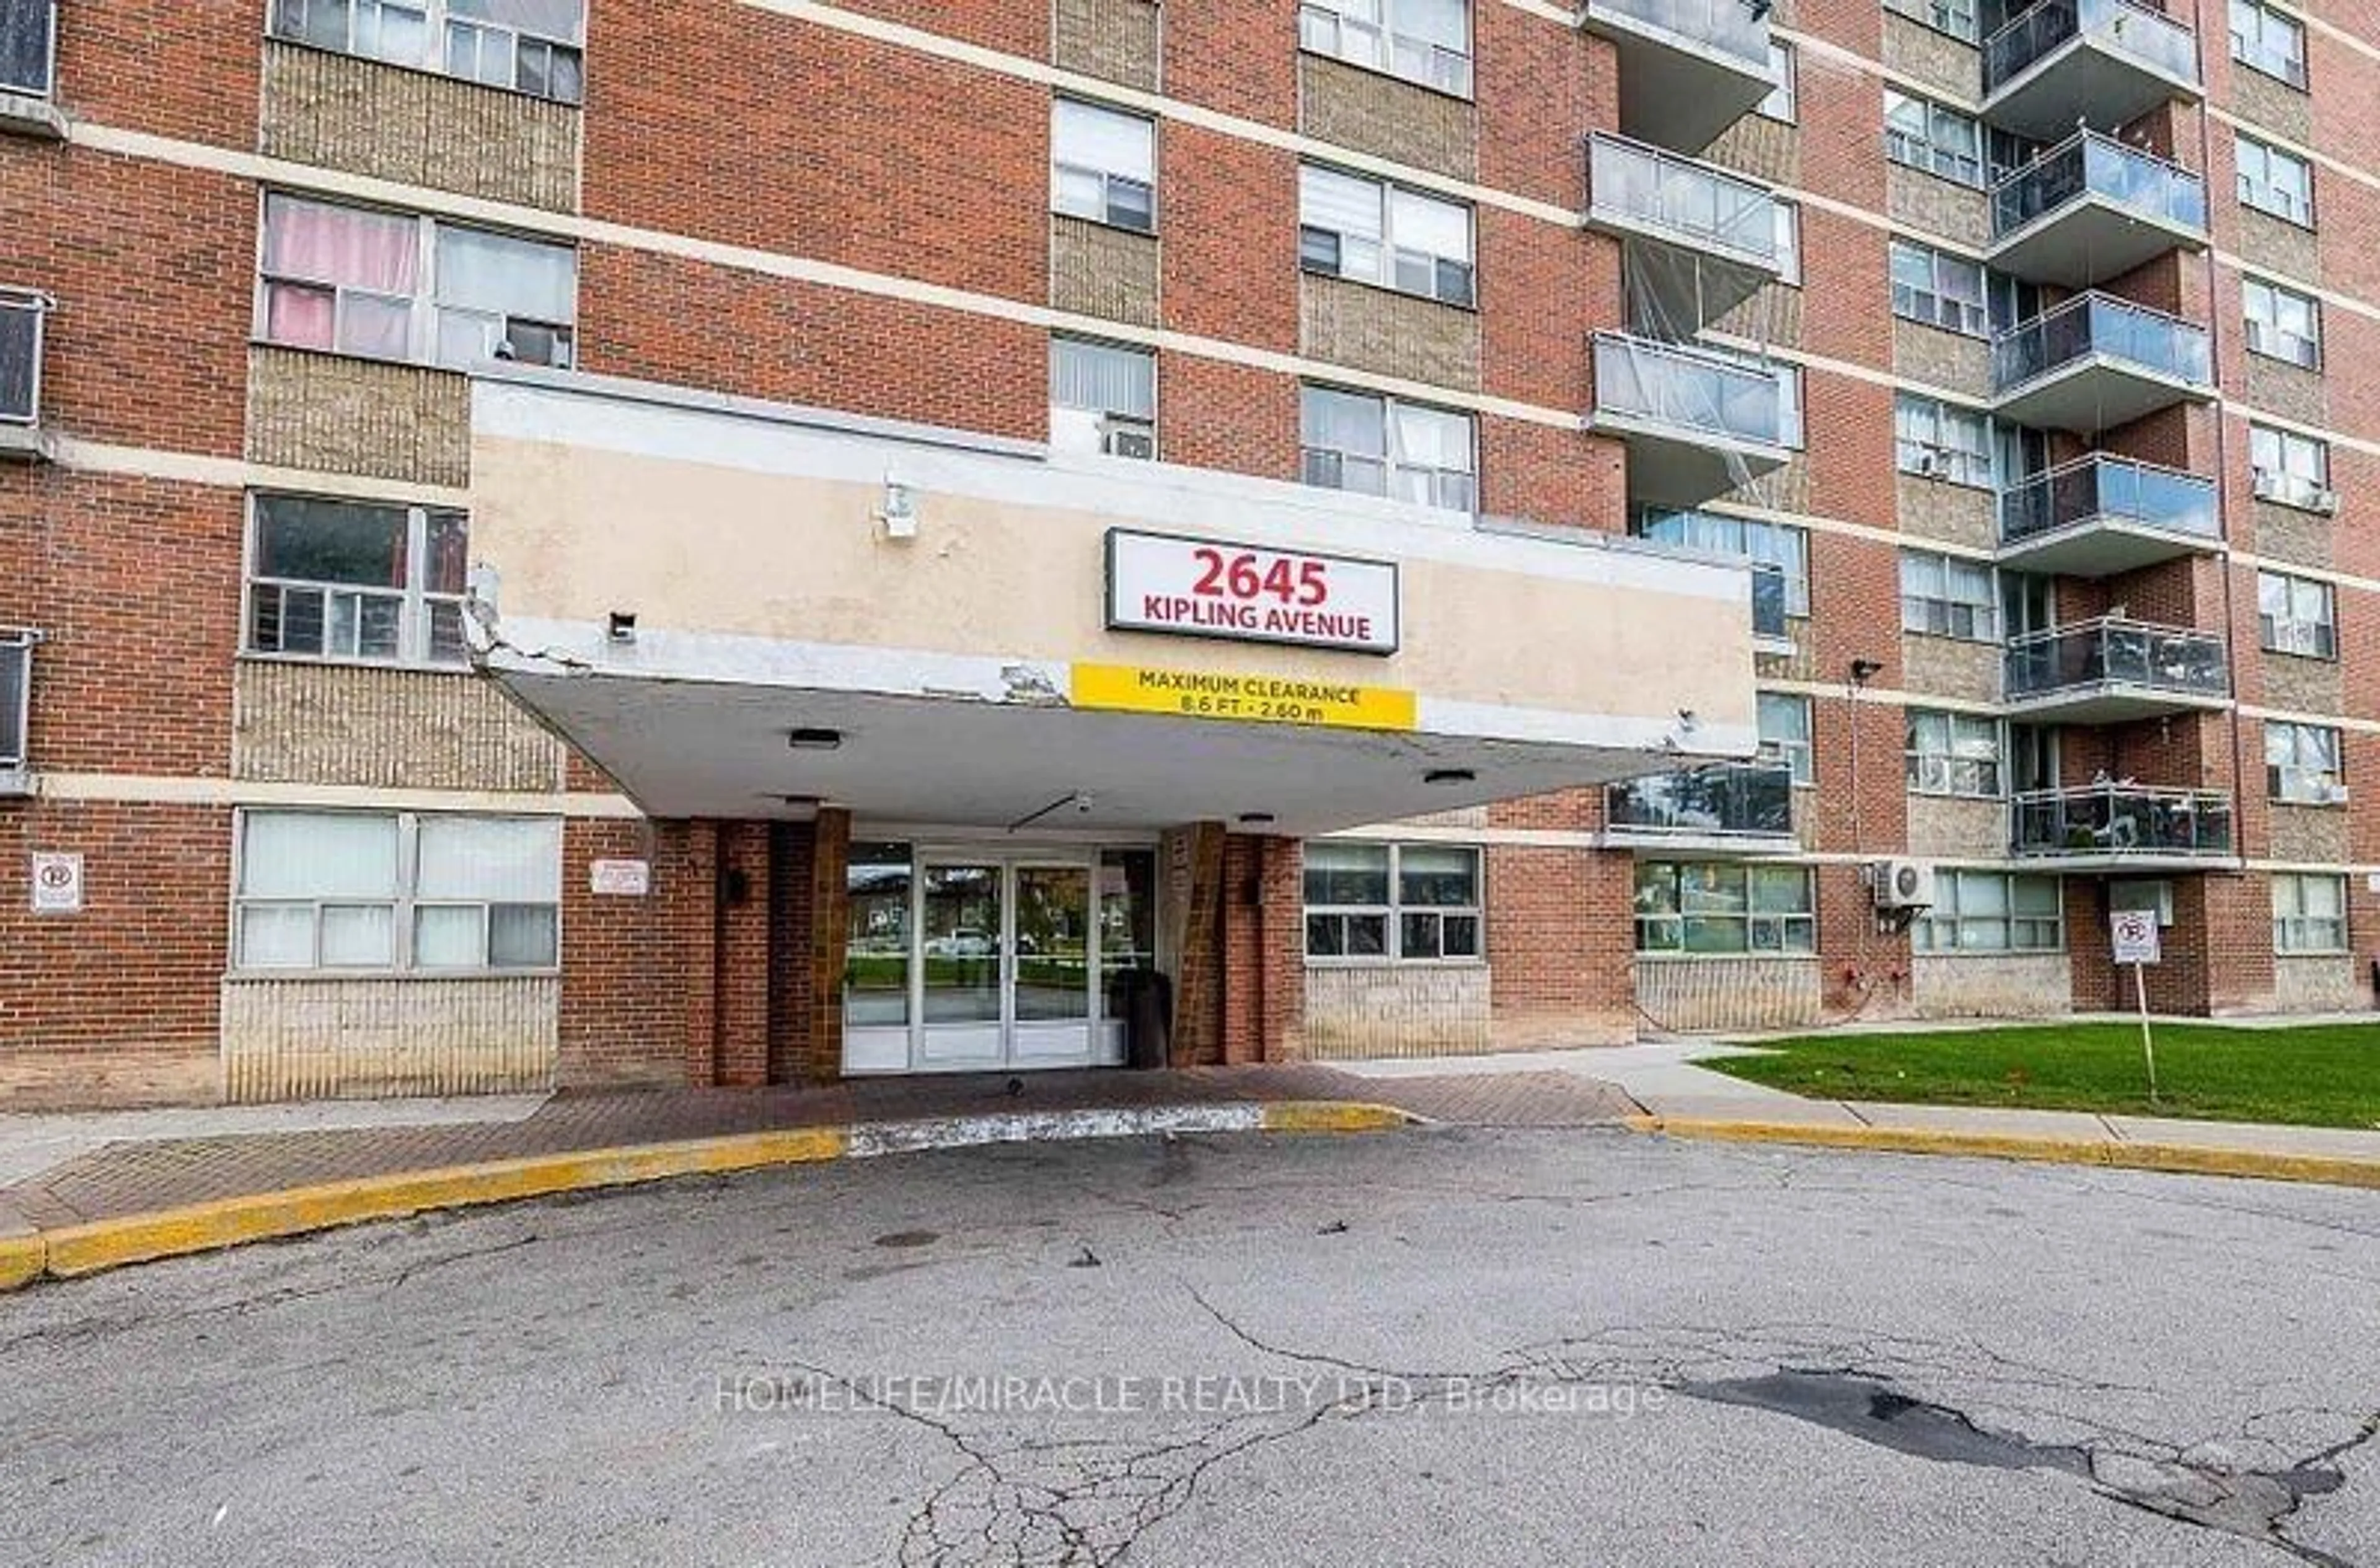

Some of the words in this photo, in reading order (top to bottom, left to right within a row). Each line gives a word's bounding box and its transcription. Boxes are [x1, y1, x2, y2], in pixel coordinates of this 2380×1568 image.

[1192, 548, 1327, 607] 2645
[1144, 594, 1258, 629] KIPLING
[1265, 608, 1371, 641] AVENUE
[1139, 671, 1239, 694] MAXIMUM
[1243, 678, 1360, 705] CLEARANCE
[1217, 698, 1241, 715] FT
